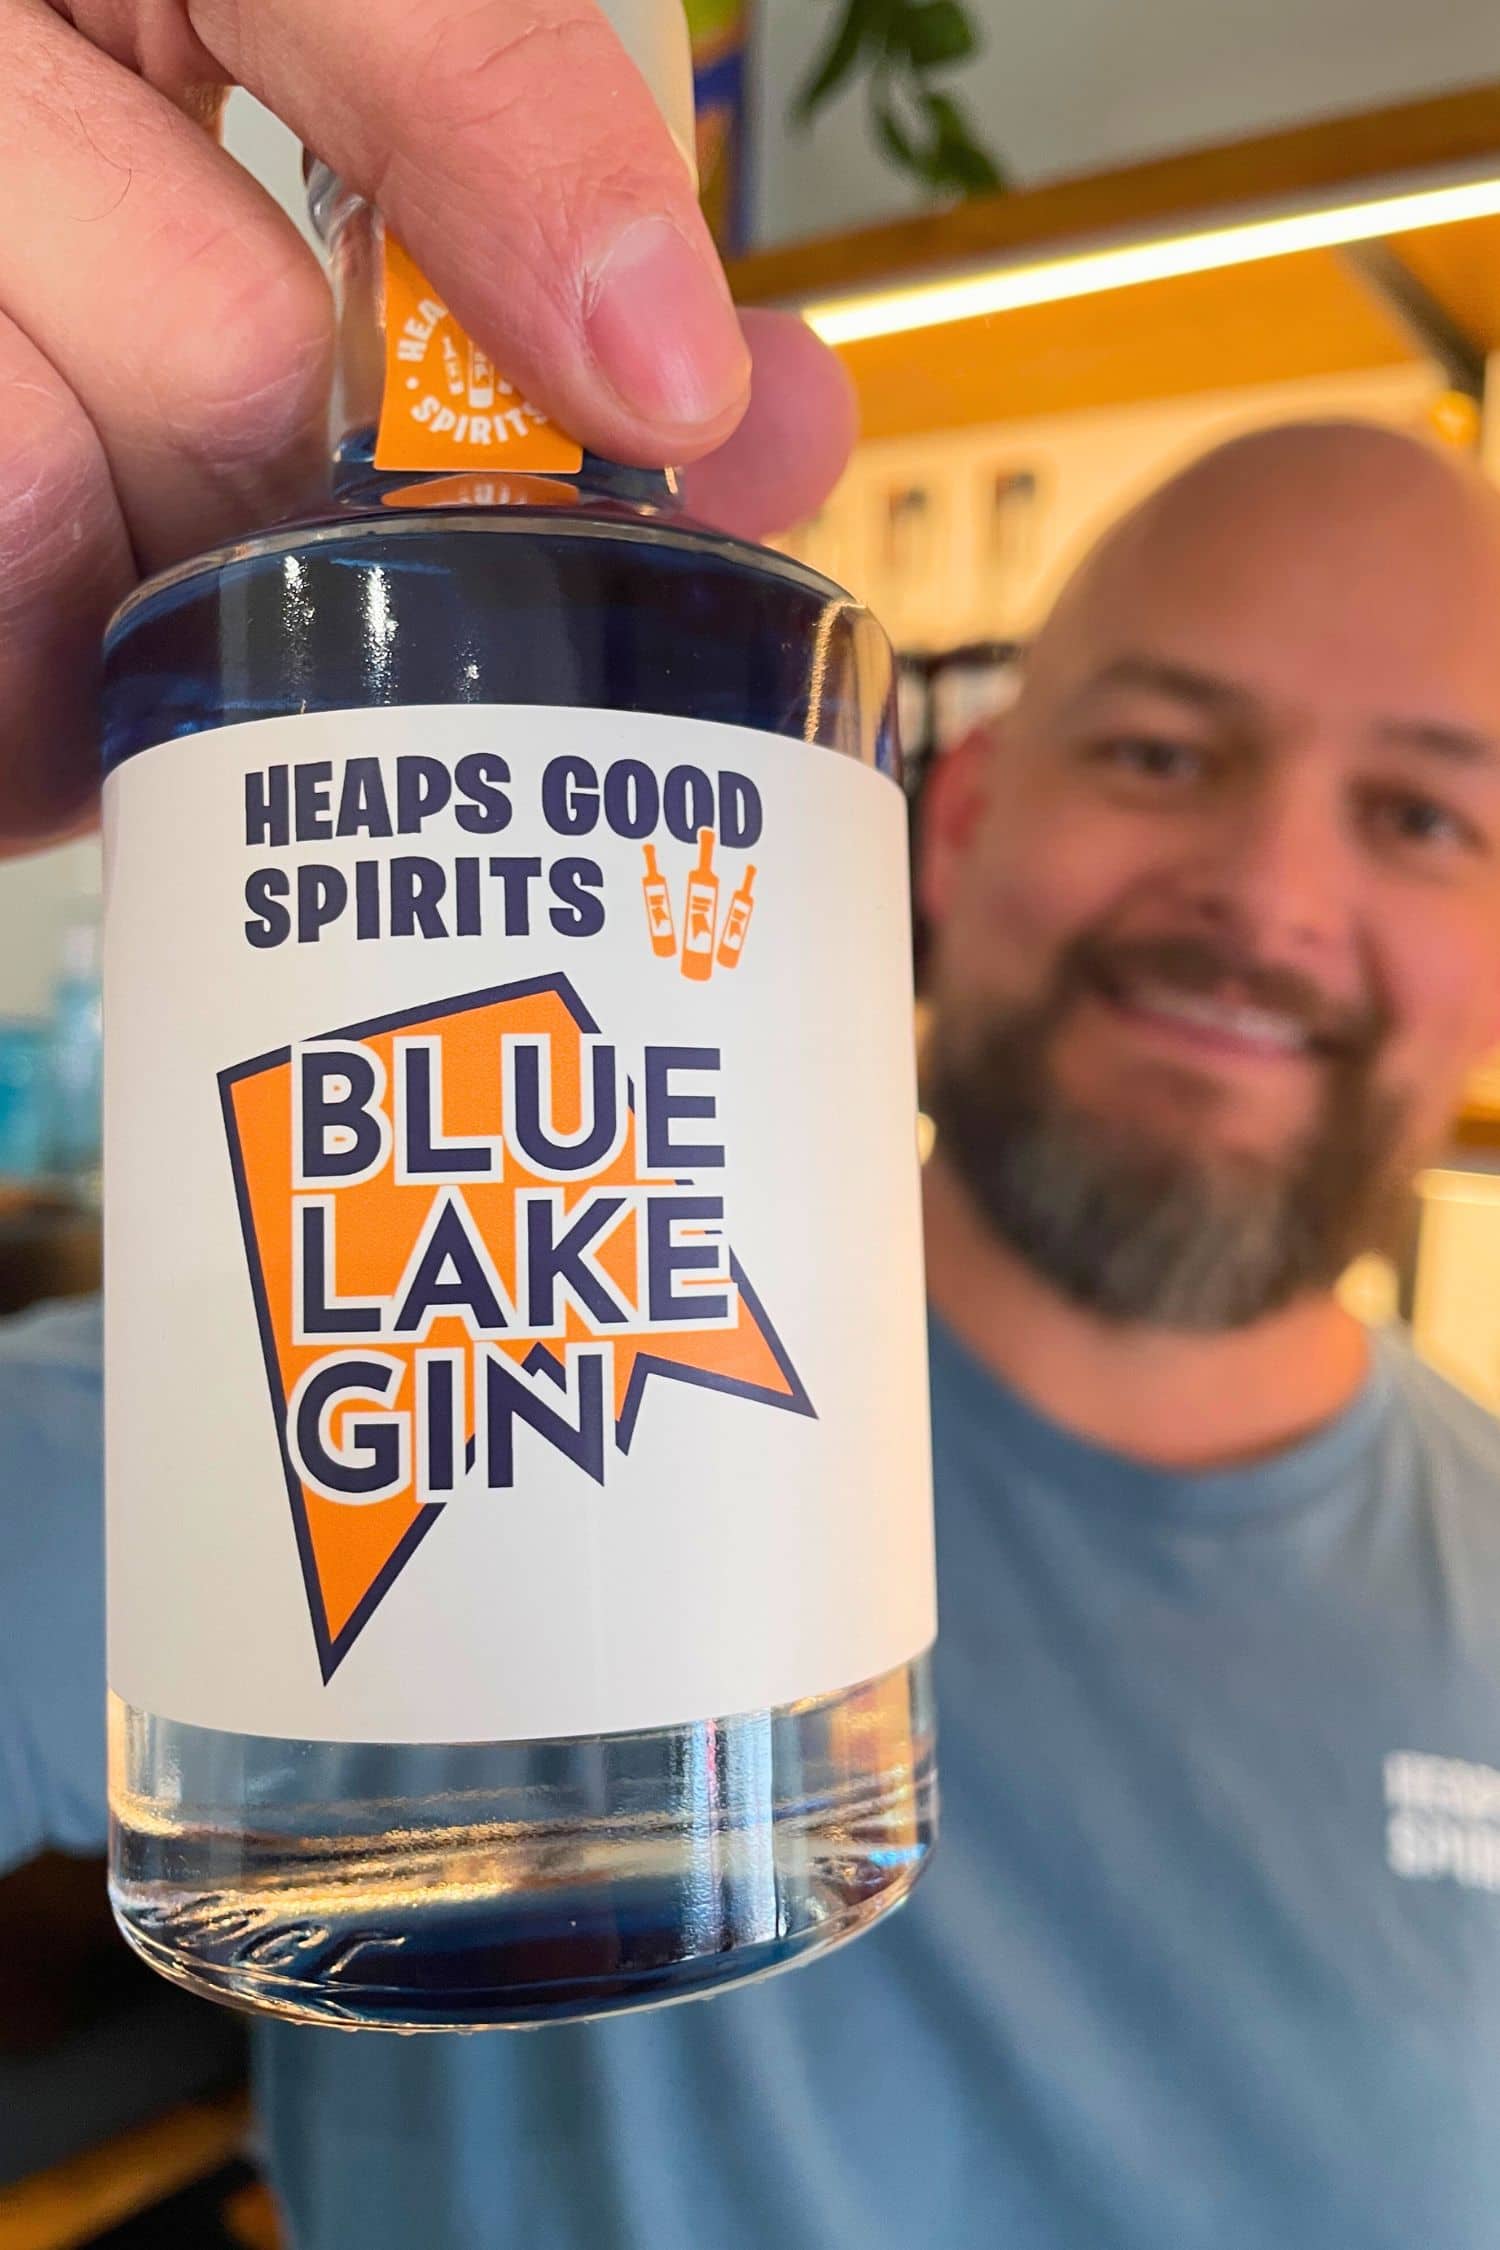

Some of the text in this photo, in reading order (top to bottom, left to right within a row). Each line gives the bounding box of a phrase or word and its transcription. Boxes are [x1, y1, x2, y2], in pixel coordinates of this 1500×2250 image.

[245, 752, 762, 849] HEAPS GOOD
[245, 856, 605, 948] SPIRITS
[301, 1045, 726, 1178] BLUE
[302, 1195, 731, 1334] LAKE
[297, 1345, 606, 1493] GIN
